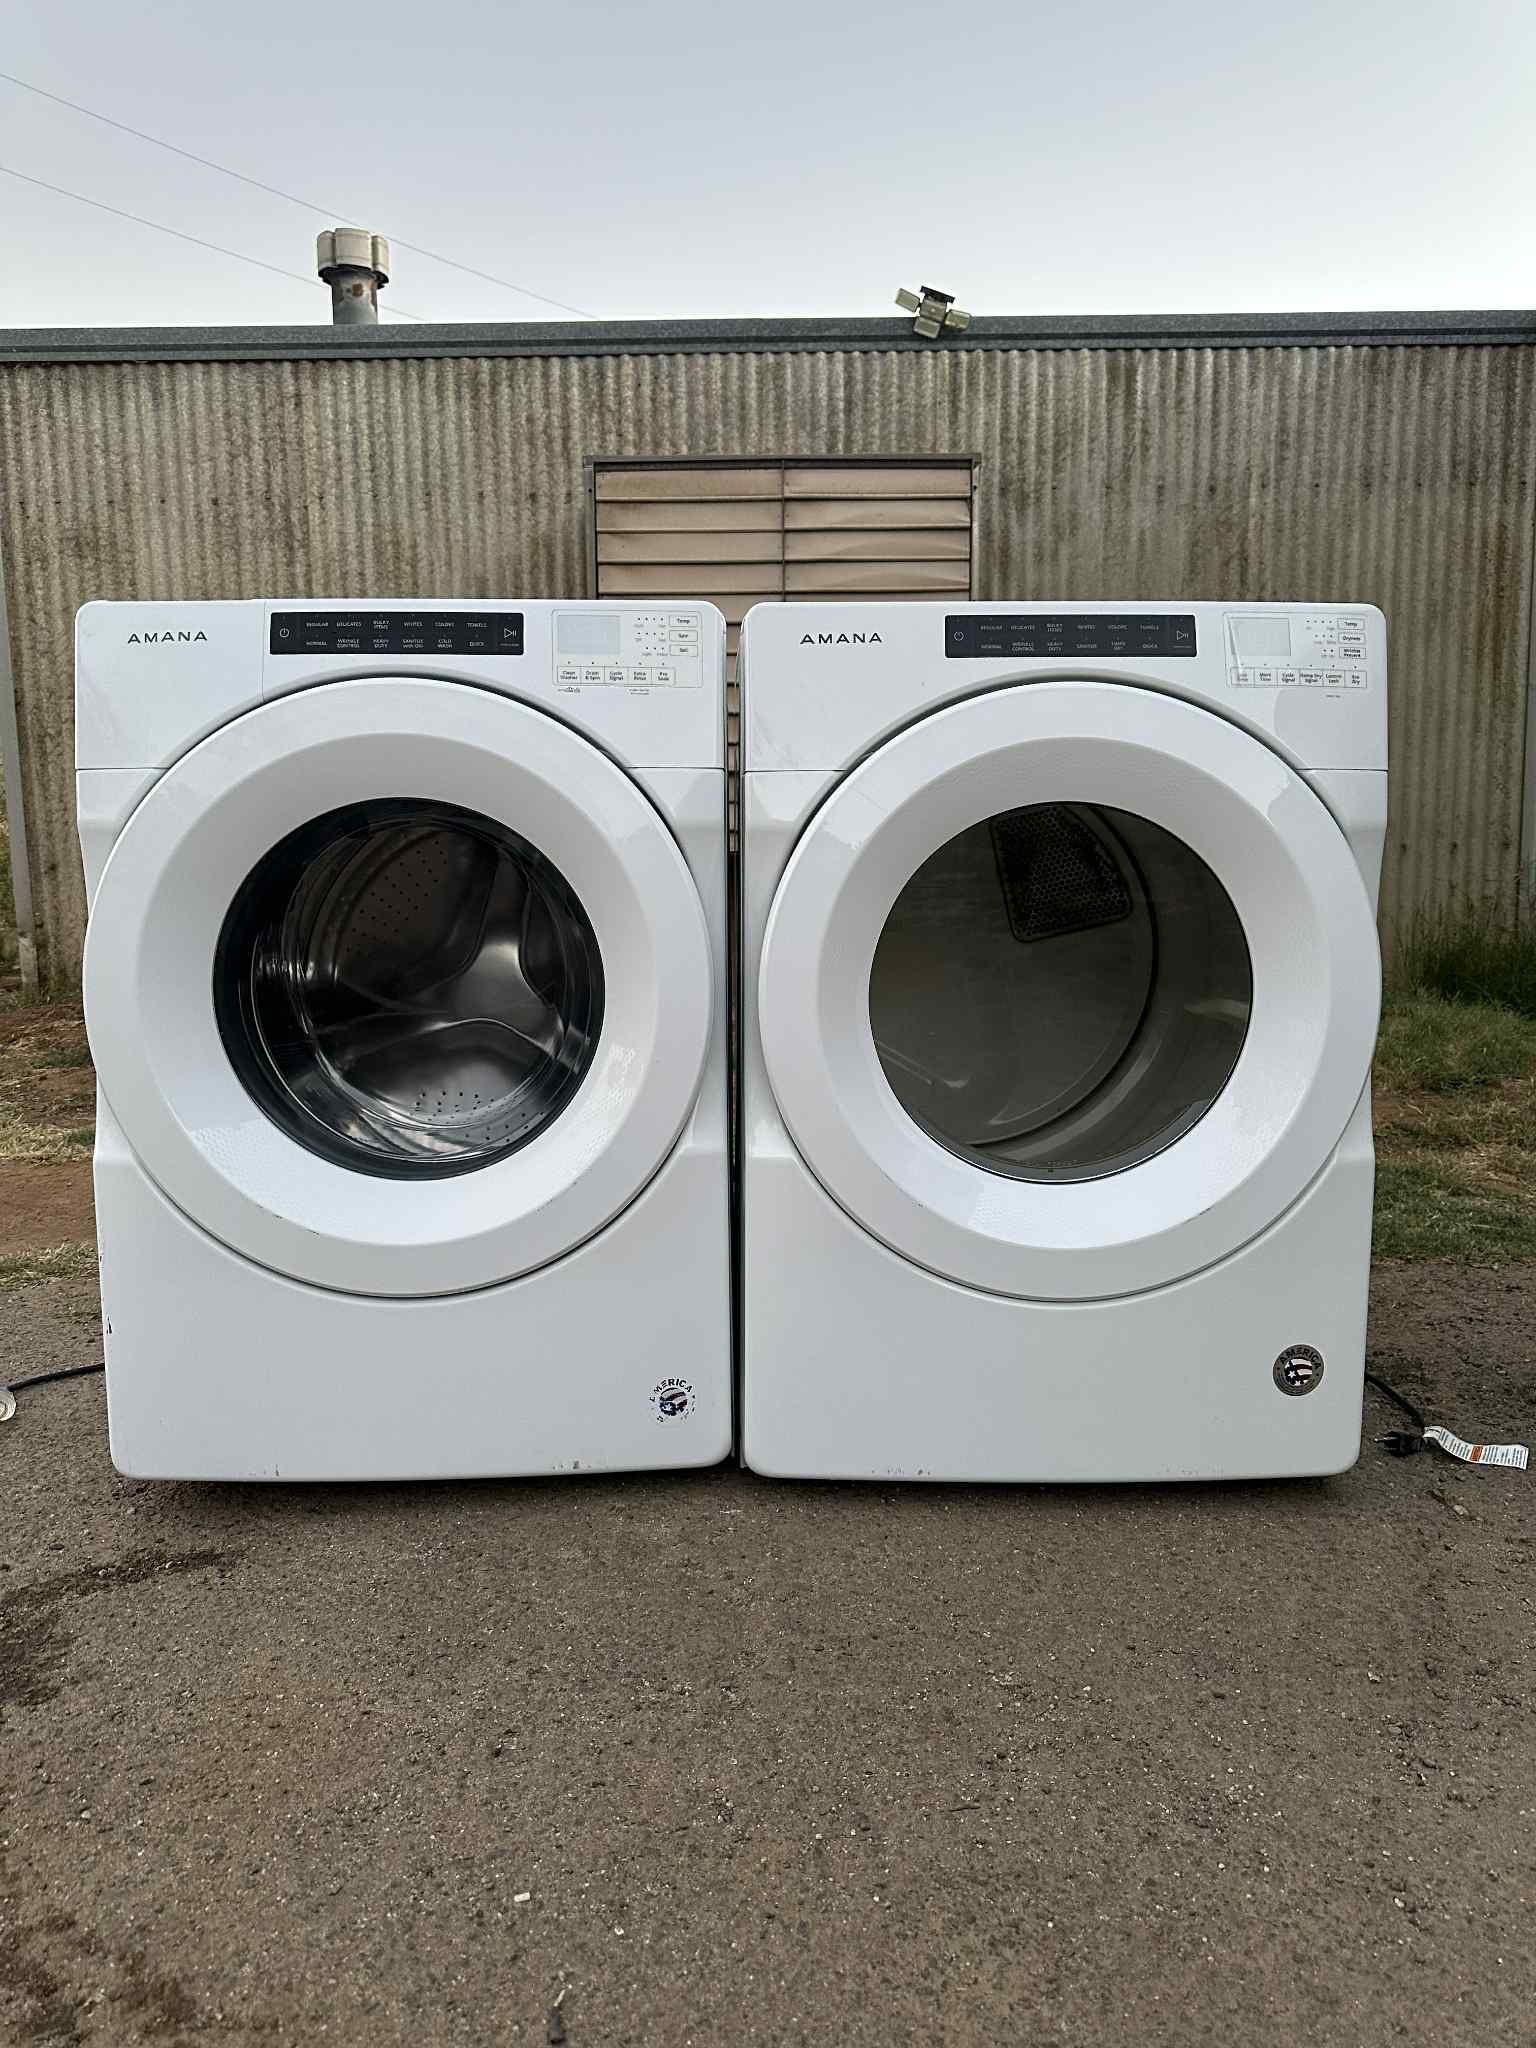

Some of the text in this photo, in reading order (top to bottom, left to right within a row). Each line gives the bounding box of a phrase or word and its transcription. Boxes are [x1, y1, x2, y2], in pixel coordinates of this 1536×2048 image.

[127, 631, 208, 644] AMANA
[800, 632, 882, 645] AMANA
[1280, 1347, 1321, 1369] AMERICA
